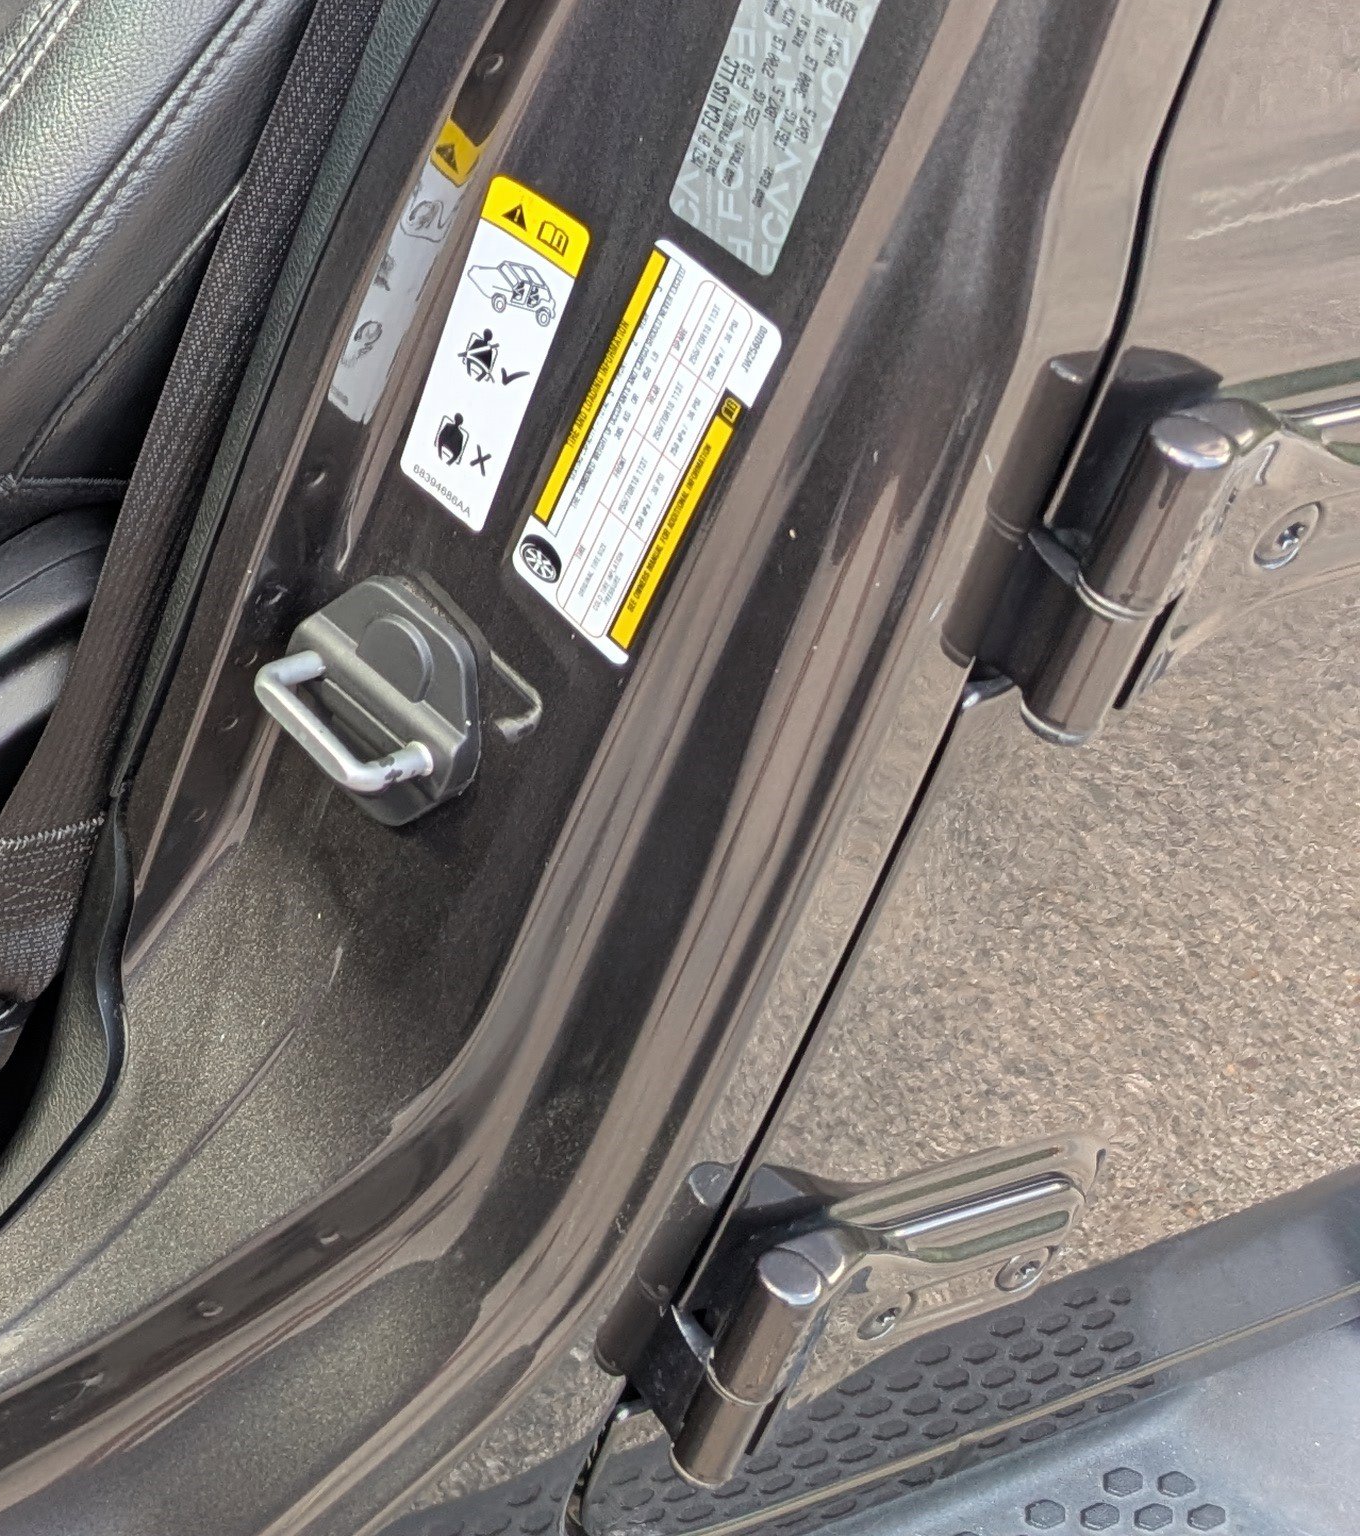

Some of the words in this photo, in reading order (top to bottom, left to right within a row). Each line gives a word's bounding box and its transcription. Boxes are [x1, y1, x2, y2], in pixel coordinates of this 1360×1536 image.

[770, 34, 787, 52] LB
[717, 53, 740, 84] LLC
[760, 51, 780, 80] 2700
[710, 79, 731, 105] US
[751, 87, 767, 106] KG
[762, 85, 786, 124] 18X7.5
[781, 107, 798, 126] KG
[801, 53, 818, 72] LB
[700, 101, 723, 133] FCA
[742, 103, 761, 131] 1225
[696, 130, 712, 147] BY
[704, 155, 720, 178] DATE
[712, 143, 725, 158] OF
[564, 425, 580, 449] TIRE
[572, 408, 588, 431] AND
[597, 318, 630, 377] INFORMATION
[412, 463, 471, 519] 68394686AA
[658, 527, 671, 545] FOR
